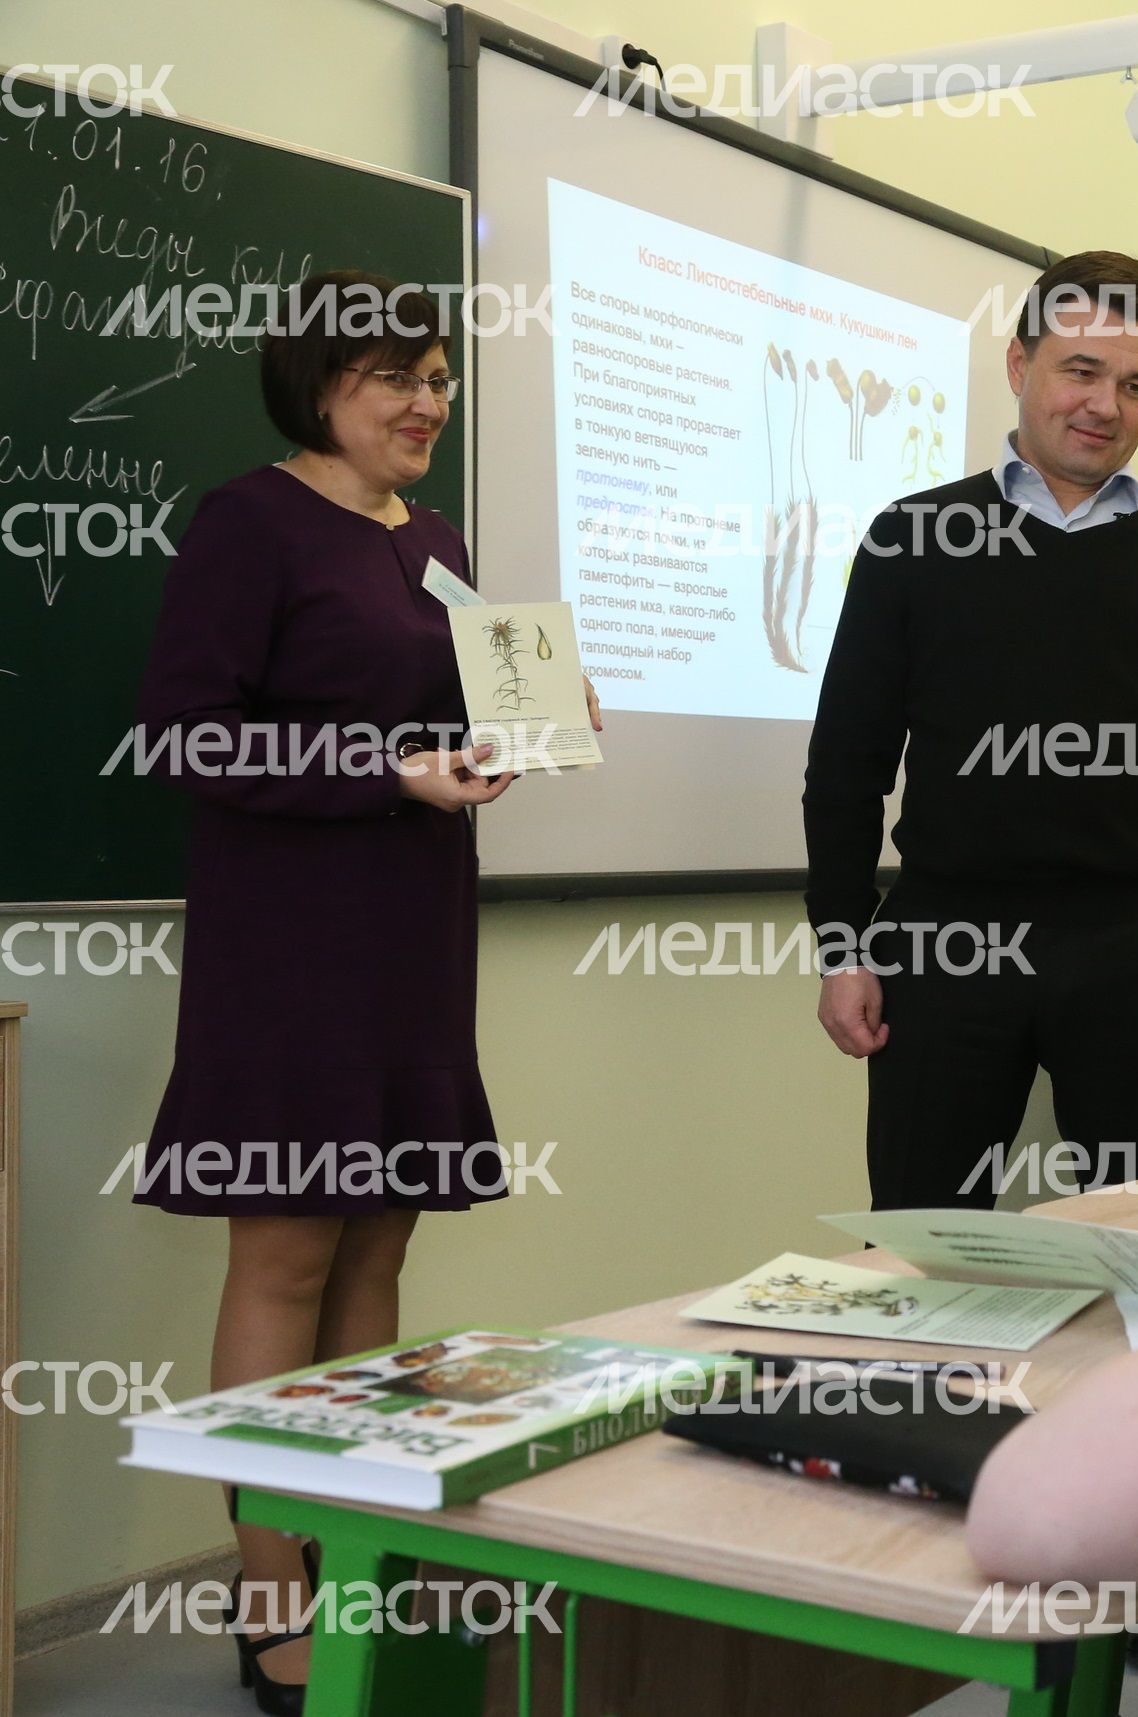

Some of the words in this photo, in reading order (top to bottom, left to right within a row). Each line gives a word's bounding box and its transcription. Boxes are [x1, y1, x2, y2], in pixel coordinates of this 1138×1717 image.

[639, 246, 682, 277] Класс
[686, 262, 806, 315] Листостебельные
[839, 312, 895, 344] Кукушкин
[898, 333, 918, 350] лен
[571, 281, 596, 302] Все
[600, 294, 640, 316] споры
[644, 307, 743, 346] морфологически
[650, 334, 672, 350] мхи
[573, 339, 672, 375] равноспоровые
[676, 367, 732, 391] растения.
[573, 362, 599, 382] При
[603, 369, 696, 406] благоприятных
[574, 392, 633, 416] условиях
[637, 407, 673, 427] спора
[677, 416, 742, 440] прорастает
[575, 418, 582, 430] в
[586, 420, 631, 442] тонкую
[635, 431, 708, 457] ветвящуюся
[575, 443, 629, 466] зеленую
[633, 456, 661, 471] нить
[656, 484, 678, 499] или
[660, 507, 677, 522] На
[577, 518, 650, 541] образуются
[694, 538, 706, 550] из
[578, 544, 629, 563] которых
[633, 553, 708, 574] развиваются
[579, 569, 654, 589] гаметофиты
[674, 582, 728, 599] взрослые
[580, 593, 637, 611] растения
[669, 606, 736, 622] какого-либо
[580, 618, 622, 632] одного
[661, 627, 716, 643] имеющие
[581, 641, 654, 659] гаплоидный
[658, 647, 692, 664] набор
[582, 665, 646, 681] хромосом.
